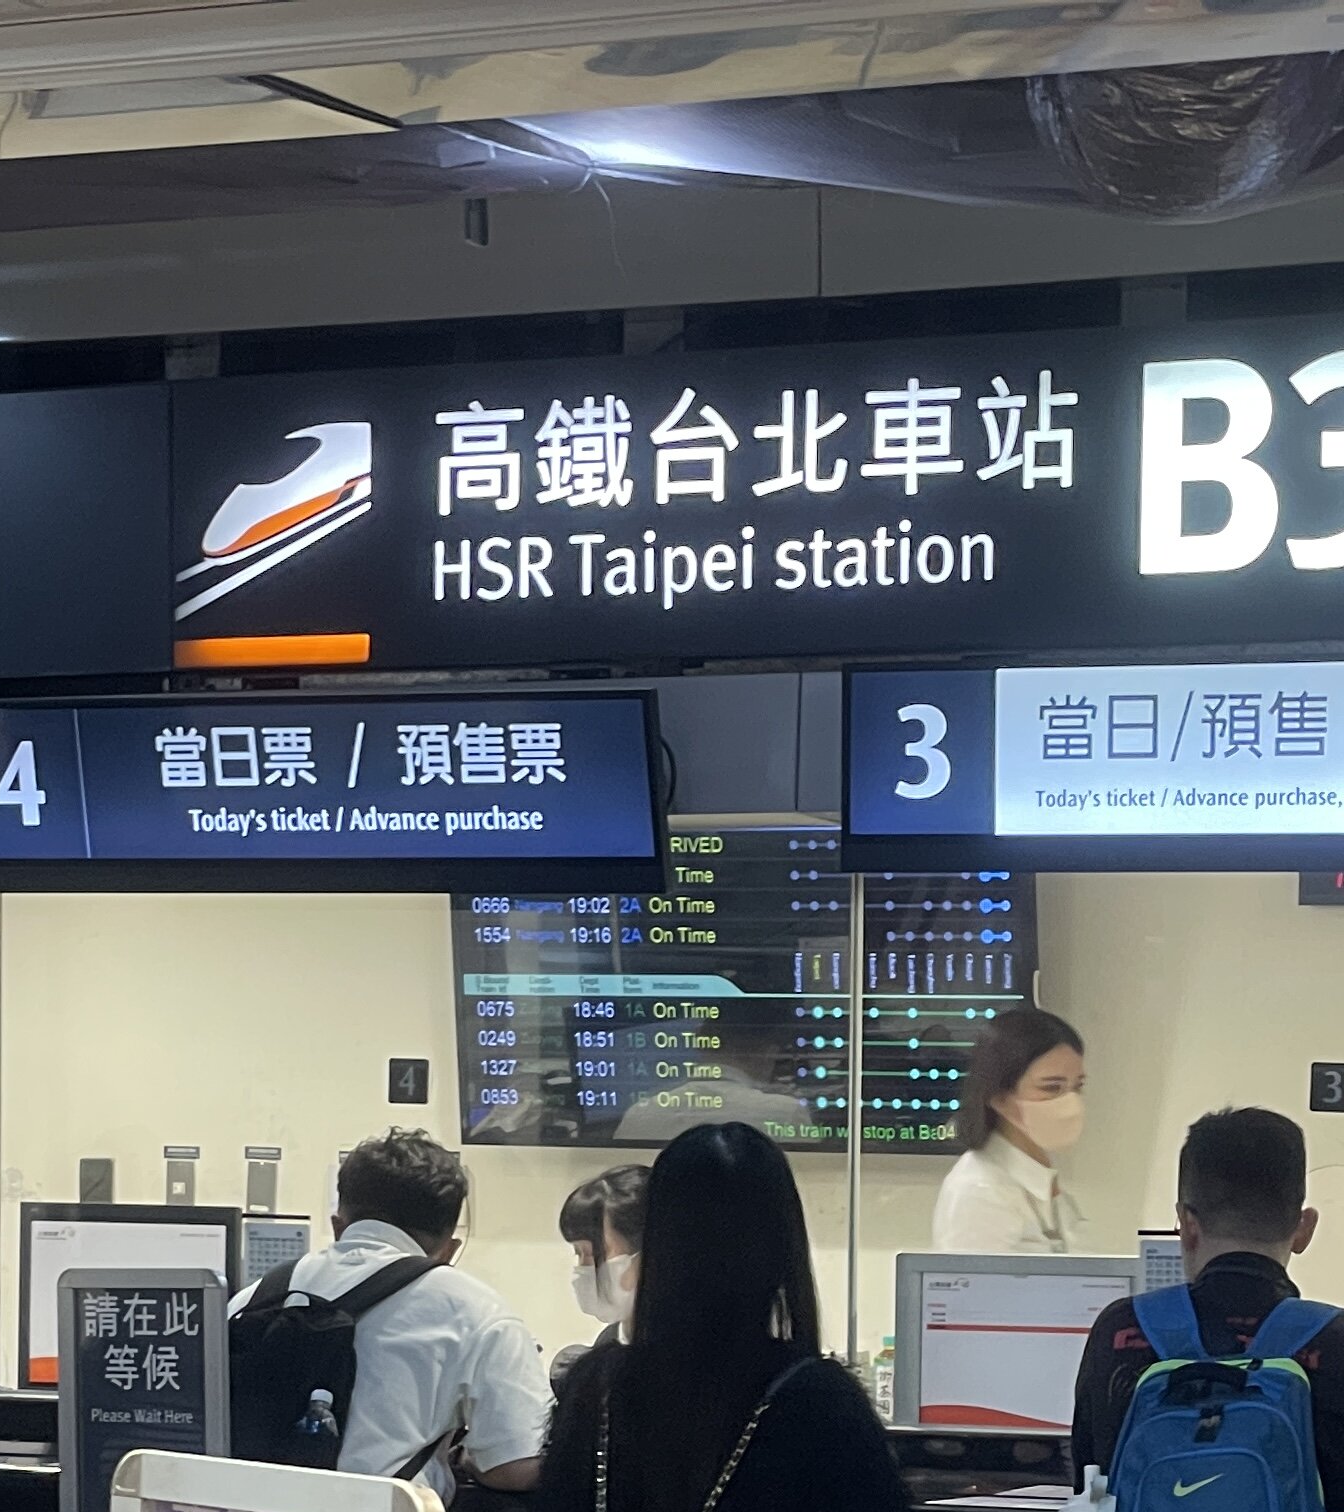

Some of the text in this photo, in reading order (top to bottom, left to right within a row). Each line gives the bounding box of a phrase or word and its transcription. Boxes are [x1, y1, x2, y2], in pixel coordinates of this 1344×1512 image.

[435, 370, 1080, 517] 高鐵台北車站
[434, 519, 994, 611] HSR Taipei station
[1039, 690, 1328, 762] 當日/預售
[155, 721, 567, 789] 當日票 / 預售票
[894, 703, 951, 800] 3
[1035, 788, 1101, 811] Today's
[1106, 788, 1156, 807] ticket
[1173, 787, 1249, 807] Advance
[1255, 786, 1343, 810] purchase,
[187, 804, 544, 837] Today's ticket Advance purchase
[675, 867, 714, 884] Time
[472, 896, 715, 914] 0666 19:02 On Time
[474, 926, 717, 944] 1554 19:16 On Time
[477, 1000, 515, 1017] 0675
[573, 1001, 615, 1018] 18:46
[653, 1002, 677, 1019] On
[680, 1002, 719, 1019] Time
[478, 1030, 516, 1047] 0249
[574, 1030, 614, 1048] 18:51
[654, 1031, 678, 1048] On
[681, 1032, 721, 1049] Time
[399, 1065, 416, 1096] 4
[480, 1059, 722, 1079] 1327 19:01 On Time
[481, 1088, 723, 1108] 0853 19:11 On Time
[1322, 1070, 1342, 1103] 3
[764, 1121, 895, 1142] This train stop
[82, 1291, 200, 1339] 請在此
[104, 1345, 181, 1391] 等候
[90, 1407, 194, 1425] Please Wait Here
